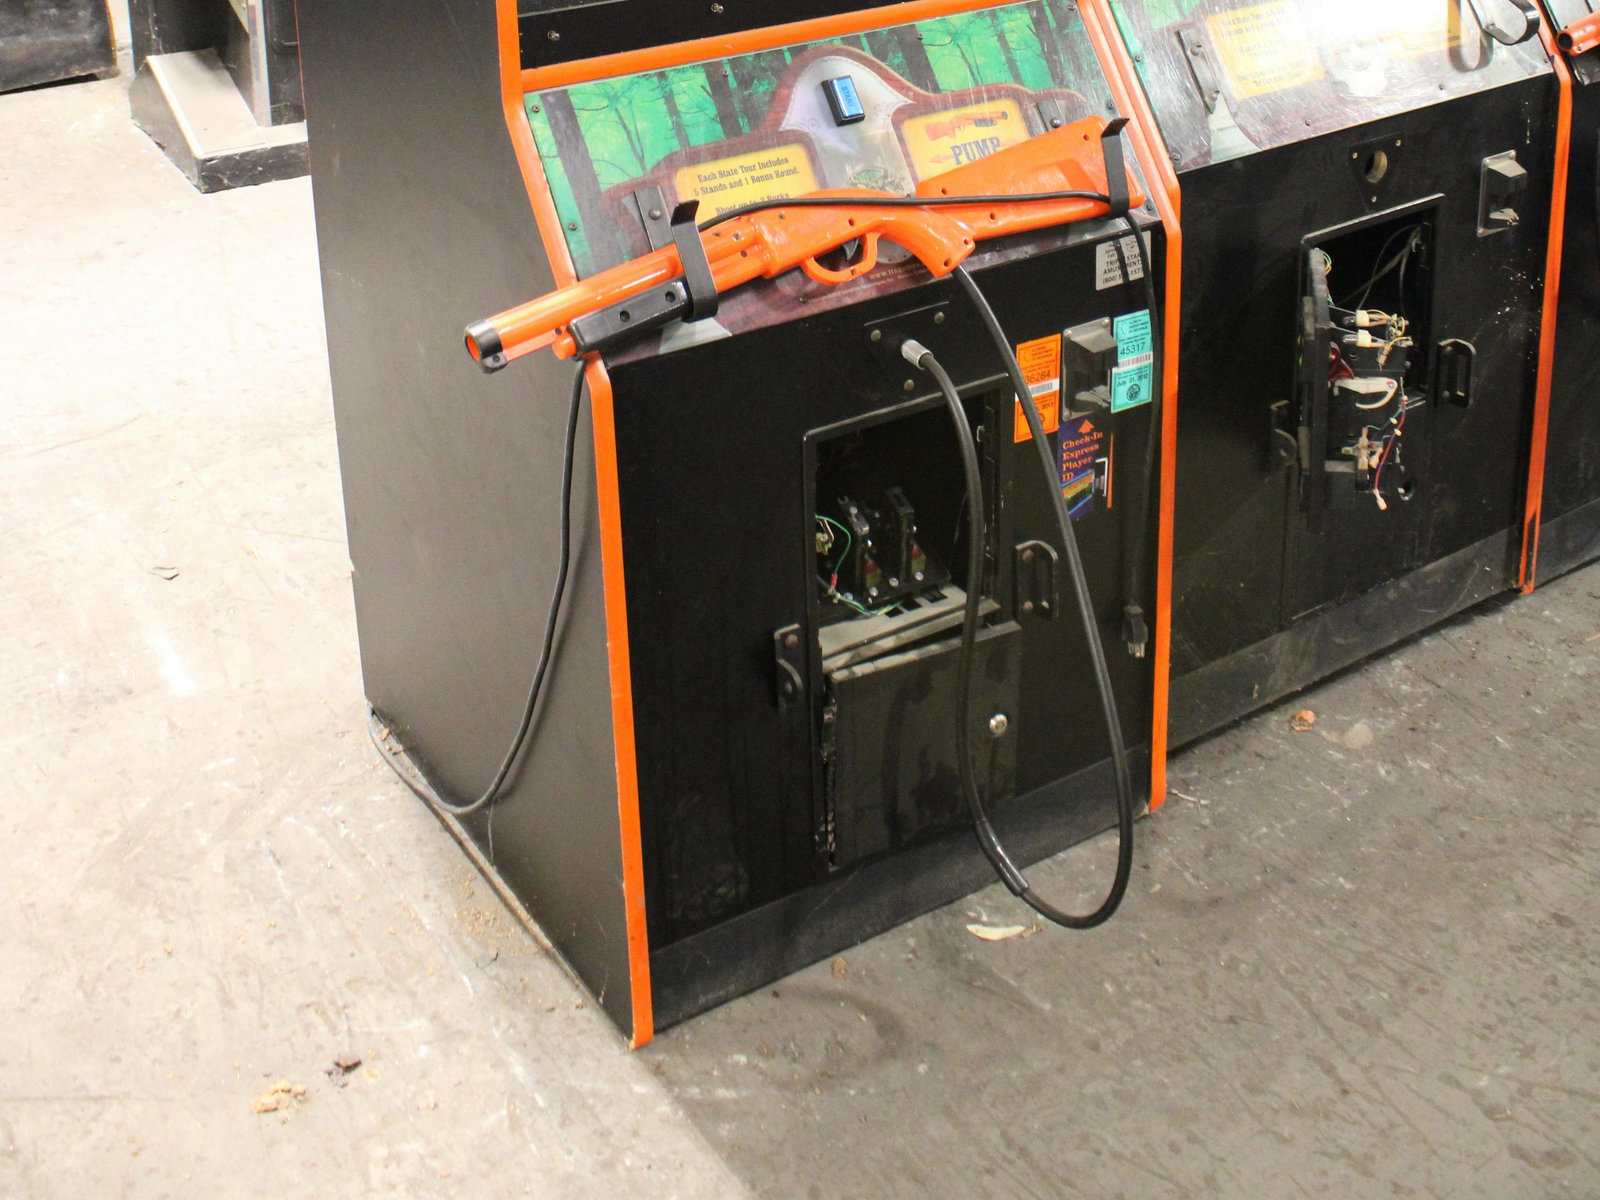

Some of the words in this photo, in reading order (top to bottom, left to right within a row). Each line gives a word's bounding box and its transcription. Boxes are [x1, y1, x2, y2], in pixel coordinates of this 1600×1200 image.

[949, 136, 1001, 166] PUMP
[697, 172, 717, 184] Each
[718, 167, 739, 179] State
[740, 163, 757, 175] Tour
[758, 156, 789, 169] Includes
[701, 182, 728, 196] Stands
[729, 178, 743, 190] and
[750, 172, 774, 184] Bonus
[1120, 341, 1146, 356] 45317
[1062, 431, 1104, 450] Check-In
[1062, 444, 1100, 461] Express
[1062, 455, 1093, 471] Player
